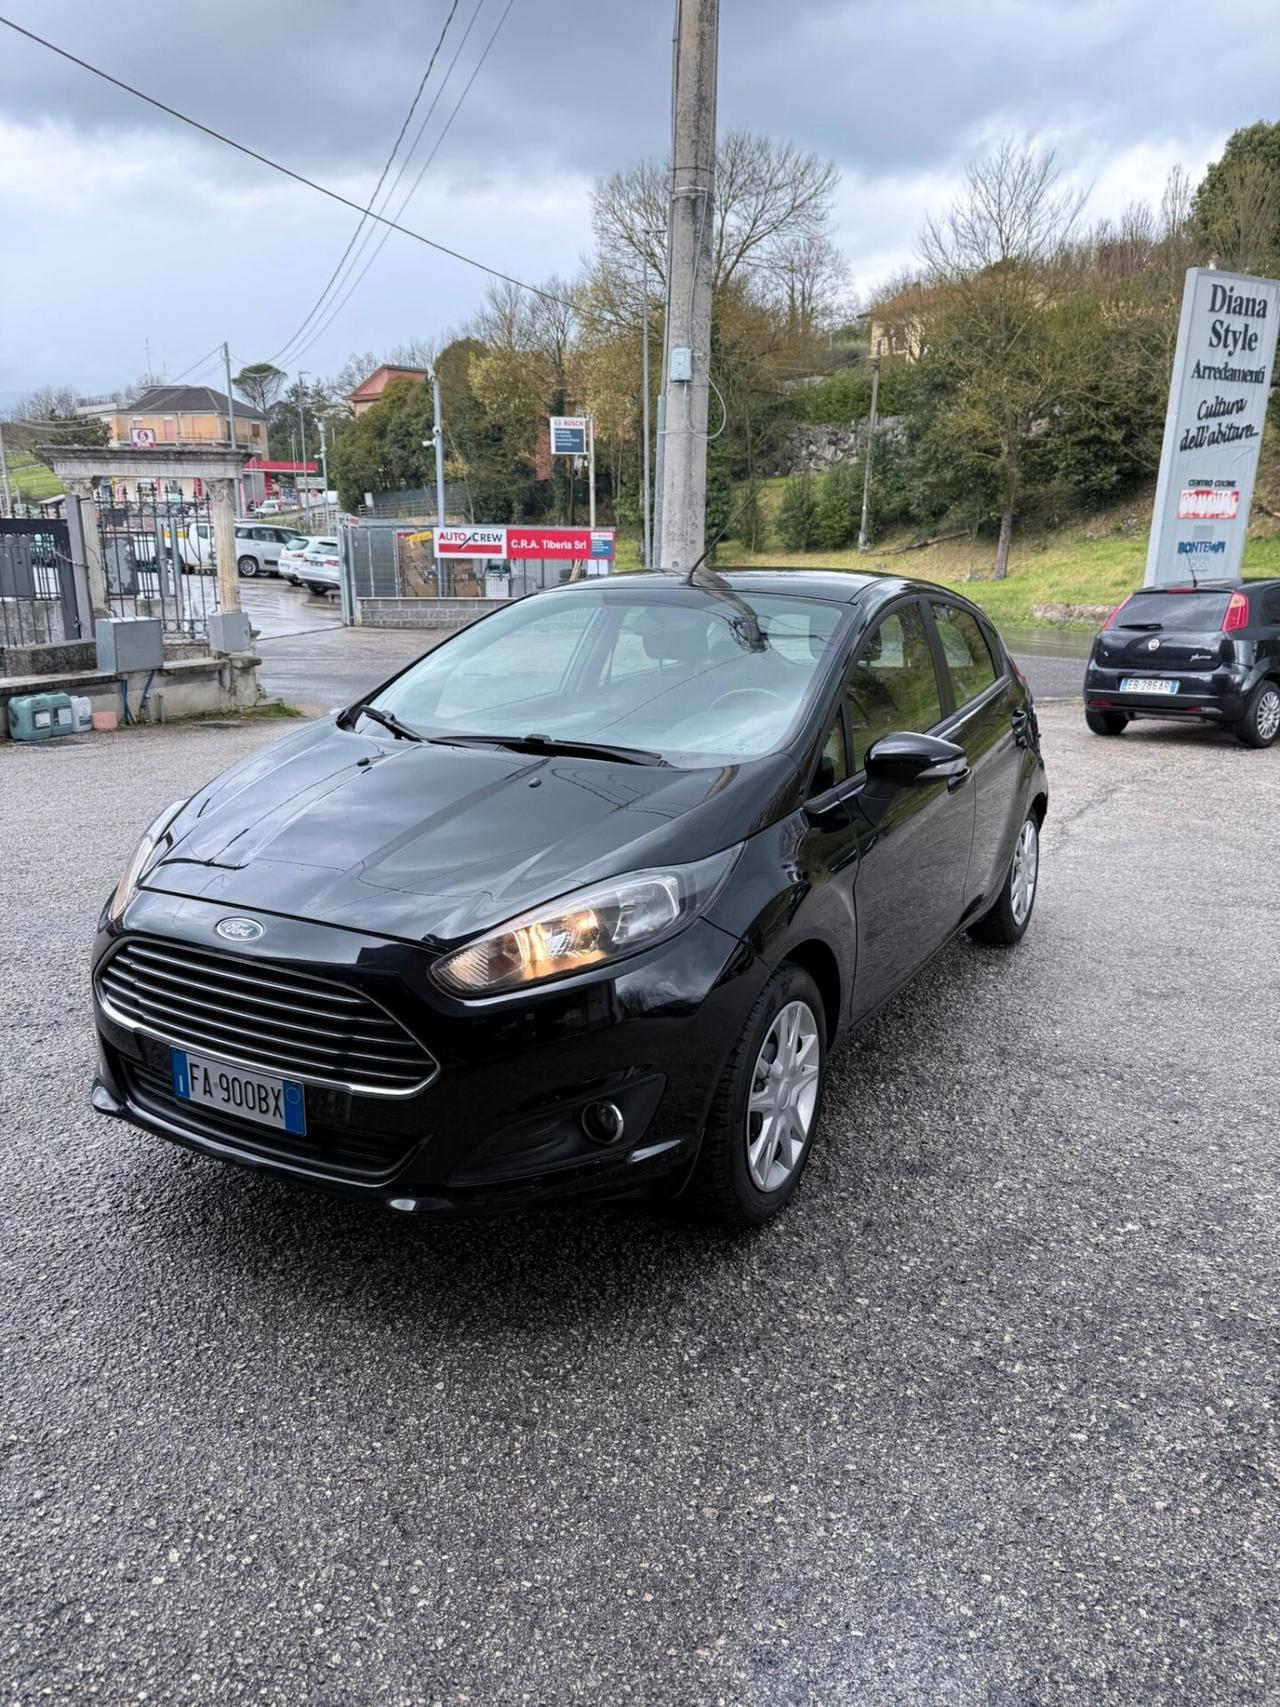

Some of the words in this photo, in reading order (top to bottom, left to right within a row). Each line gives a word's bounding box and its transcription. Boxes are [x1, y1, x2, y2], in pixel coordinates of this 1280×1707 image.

[1208, 284, 1268, 319] Diana
[1209, 319, 1259, 357] Style
[1191, 358, 1266, 384] Arredamenti
[1197, 395, 1248, 420] Cultura
[1188, 479, 1213, 487] CENTRO
[511, 540, 540, 549] C.R.A.
[542, 539, 573, 550] Tiberia
[574, 540, 587, 550] Srl
[223, 920, 254, 937] Ford
